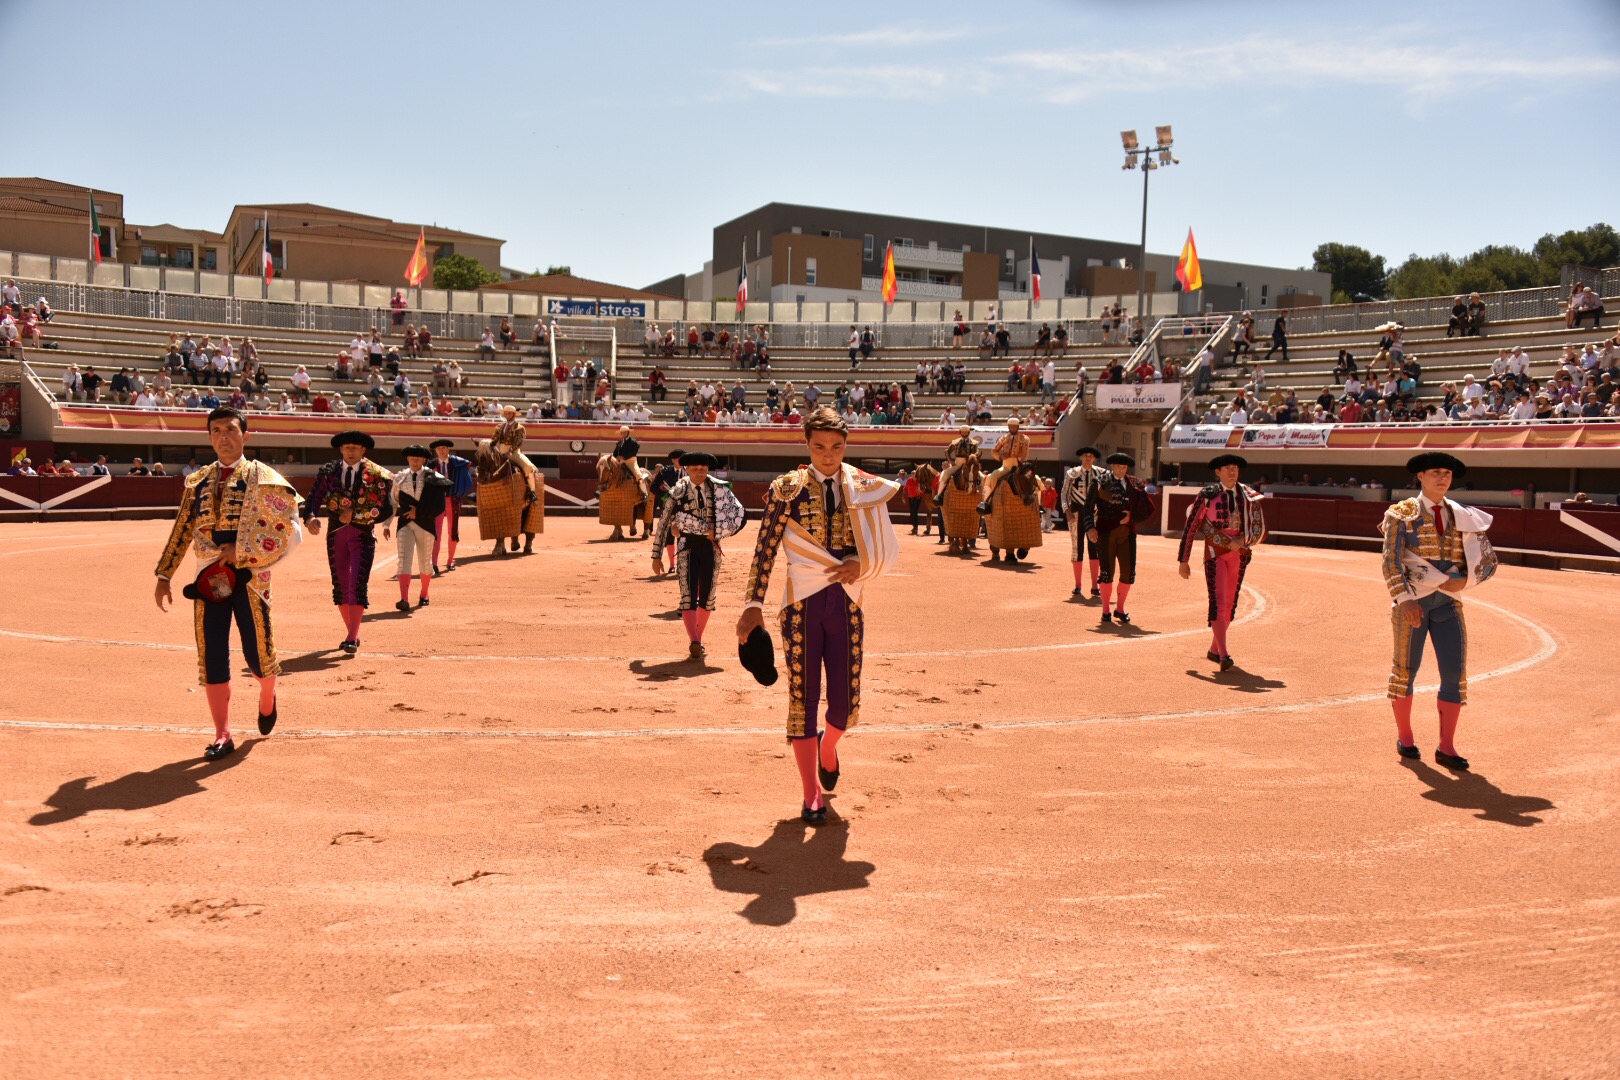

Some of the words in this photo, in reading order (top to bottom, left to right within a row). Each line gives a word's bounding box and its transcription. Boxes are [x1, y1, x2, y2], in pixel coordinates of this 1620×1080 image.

[567, 304, 584, 315] ville
[1258, 431, 1276, 440] Pepe
[1291, 431, 1320, 441] Montijo
